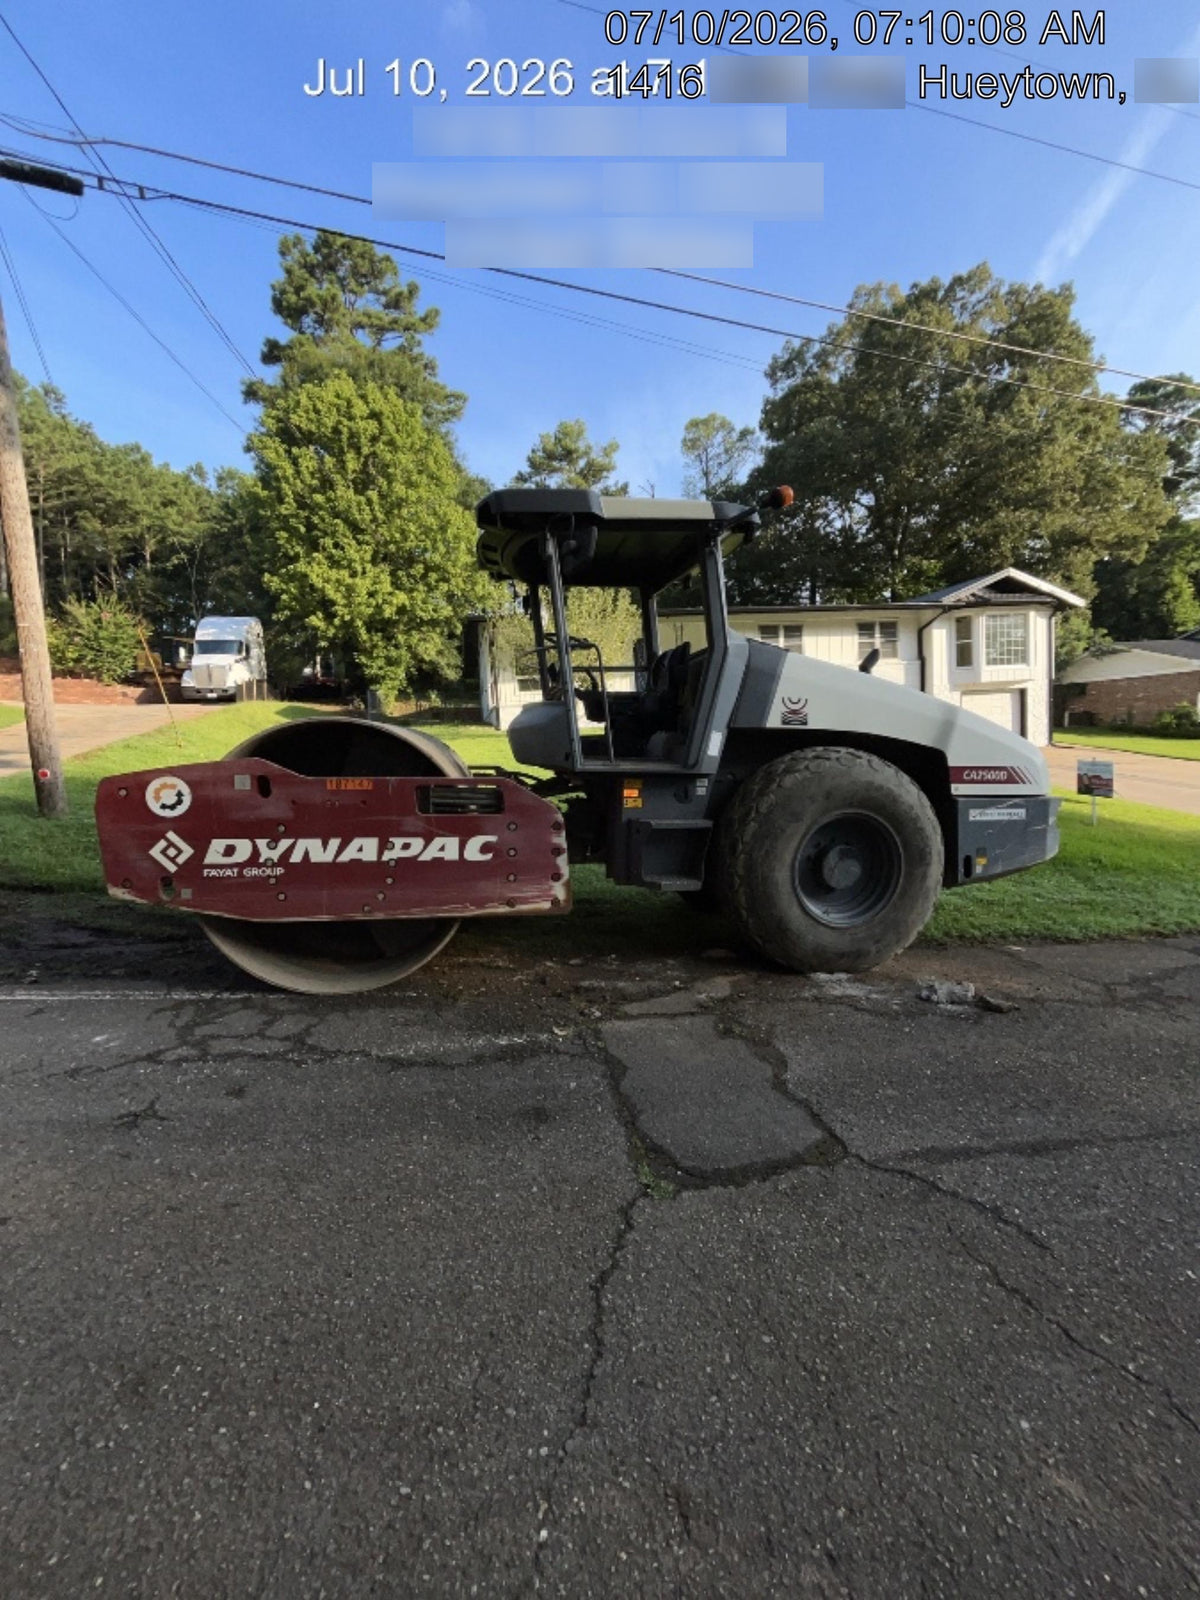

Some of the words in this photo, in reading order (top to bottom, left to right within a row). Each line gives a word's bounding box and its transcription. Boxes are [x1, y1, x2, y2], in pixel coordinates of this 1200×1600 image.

[202, 835, 498, 864] DYNAPAC
[203, 868, 238, 877] FAYAT
[243, 867, 285, 877] GROUP
